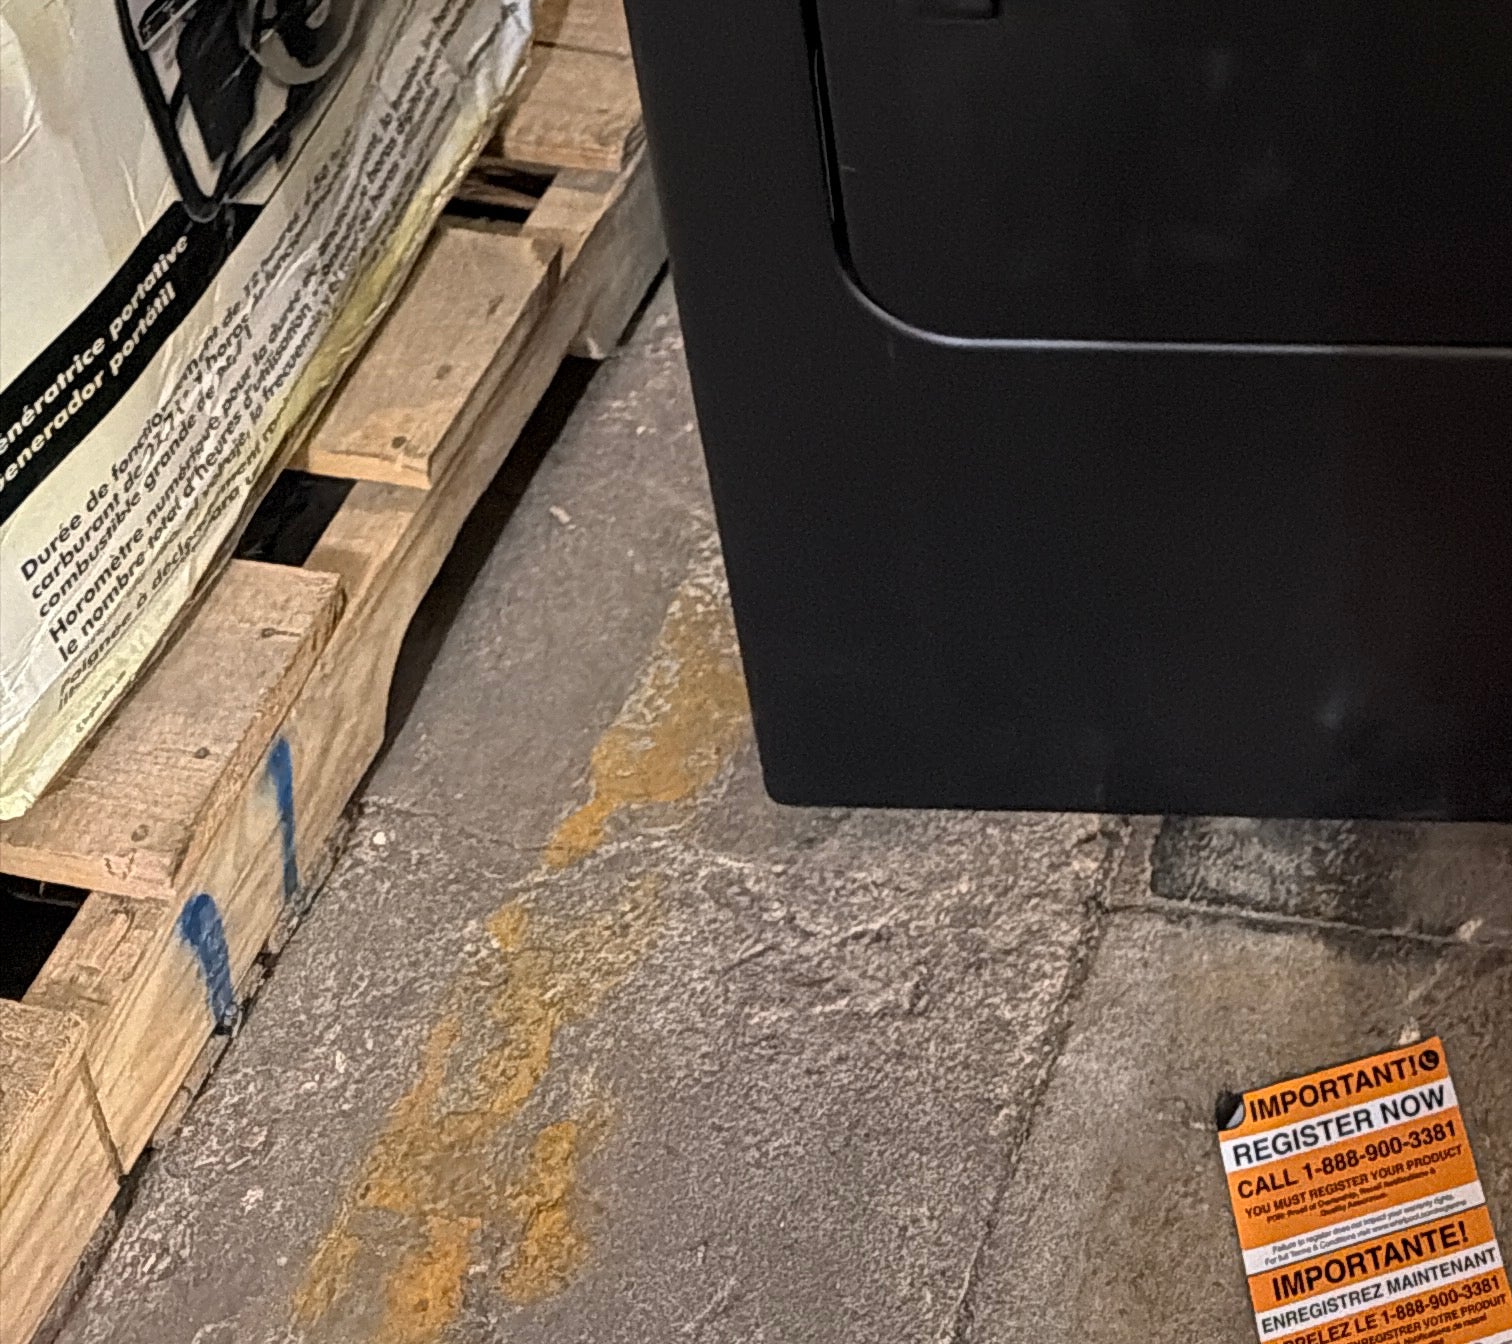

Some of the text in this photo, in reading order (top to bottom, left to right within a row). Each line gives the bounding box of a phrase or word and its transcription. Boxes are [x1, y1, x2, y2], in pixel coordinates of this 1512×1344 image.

[108, 235, 188, 342] portative
[109, 281, 177, 376] portátil
[20, 513, 83, 582] Durée
[86, 482, 110, 513] de
[221, 300, 241, 329] de
[31, 492, 121, 600] carburant
[123, 462, 144, 495] de
[38, 490, 142, 618] combustible
[143, 413, 197, 493] grande
[48, 527, 144, 644] Horomètre
[221, 365, 252, 417] pour
[57, 637, 79, 662] le
[81, 551, 146, 638] nombre
[149, 496, 183, 549] total
[183, 411, 242, 499] d'heures
[1232, 1085, 1445, 1166] REGISTER NOW
[1249, 1056, 1418, 1122] IMPORTANT!
[1238, 1119, 1457, 1199] CALL 1-888-900-3381
[1244, 1143, 1464, 1218] YOU MUST REGISTER YOUR PRODUCT
[1263, 1256, 1276, 1265] For
[1272, 1220, 1469, 1301] IMPORTANTE!
[1305, 1229, 1332, 1243] register
[1261, 1247, 1496, 1334] ENREGISTREZ MAINTENANT
[1354, 1313, 1379, 1333] LE
[1381, 1276, 1501, 1327] 1-888-900-3381
[1421, 1308, 1458, 1328] VOTRE
[1459, 1292, 1508, 1316] PRODUIT
